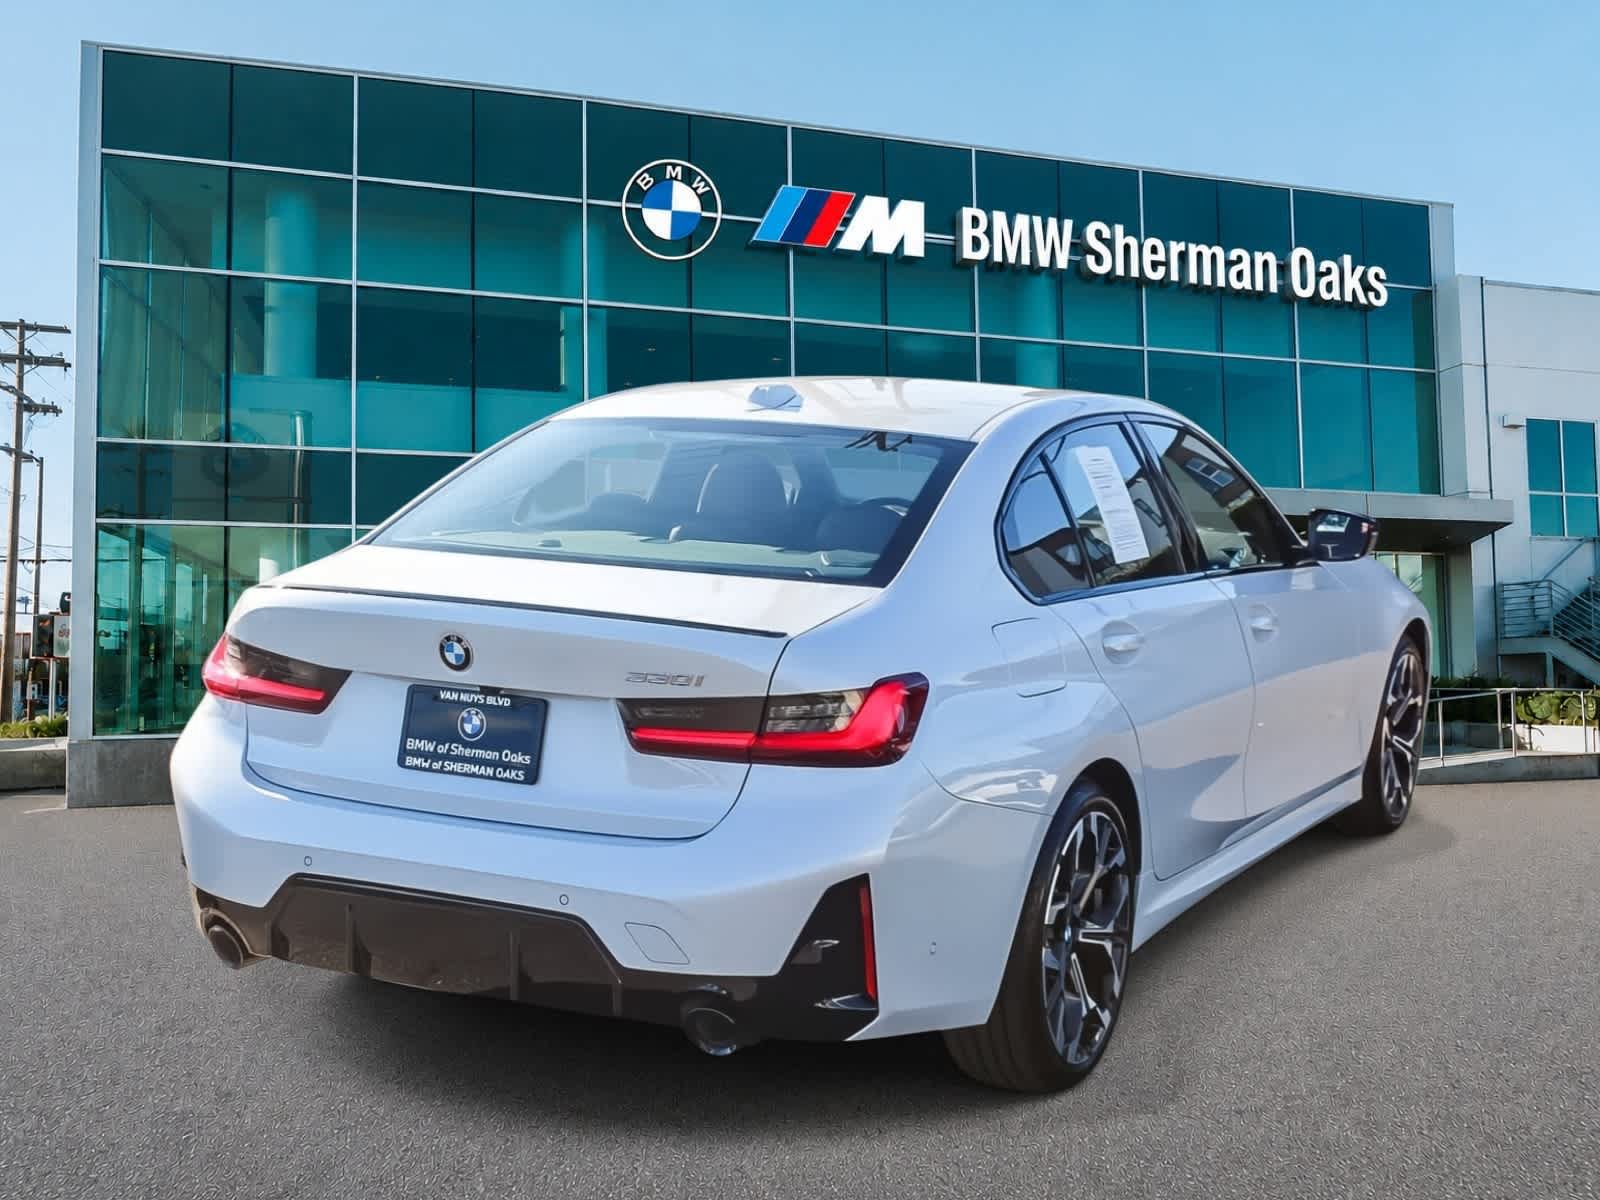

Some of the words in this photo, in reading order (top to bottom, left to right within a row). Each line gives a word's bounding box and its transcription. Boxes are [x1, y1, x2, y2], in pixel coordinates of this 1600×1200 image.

[637, 165, 711, 195] BMW
[835, 194, 925, 257] M
[961, 206, 1073, 270] BMW
[1085, 221, 1278, 294] Sherman
[1289, 246, 1389, 308] Oaks
[439, 690, 459, 701] VAN
[459, 693, 485, 704] NUYS
[486, 695, 511, 706] BLVD
[405, 738, 436, 752] BMW
[437, 743, 450, 754] of
[450, 743, 499, 760] Sherman
[501, 749, 531, 765] Oaks
[405, 756, 431, 768] BMW
[431, 760, 443, 770] of
[443, 760, 494, 777] SHERMAN
[496, 768, 525, 781] OAKS
